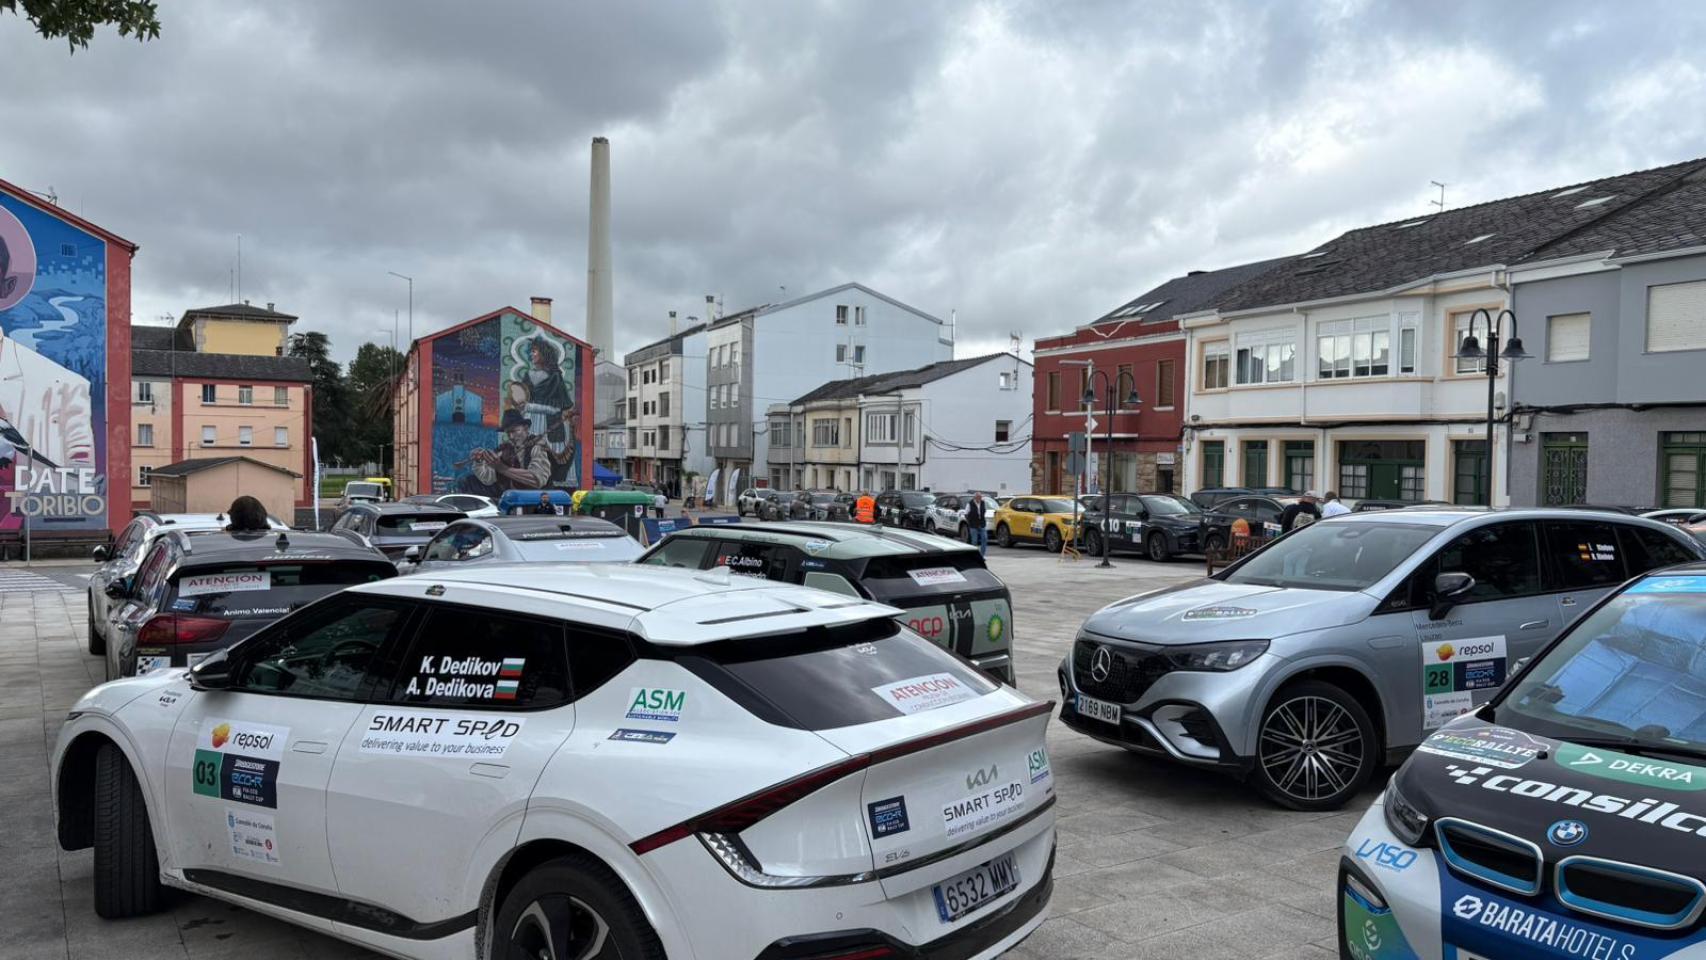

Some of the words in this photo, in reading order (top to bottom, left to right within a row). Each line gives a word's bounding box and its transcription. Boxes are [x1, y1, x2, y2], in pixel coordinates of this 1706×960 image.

[15, 466, 96, 494] DATE
[4, 492, 105, 516] TORIBIO
[1459, 642, 1494, 656] repsol
[420, 656, 435, 673] K.
[440, 657, 501, 676] Dedikov
[406, 677, 421, 695] A.
[425, 678, 494, 698] Dedikova
[889, 677, 958, 701] ATENCIÓN
[1428, 671, 1449, 687] 28
[629, 688, 685, 713] ASM
[1080, 697, 1099, 716] 2169
[1100, 703, 1118, 720] NBM
[369, 716, 449, 734] SMART
[233, 733, 274, 750] repsol
[361, 737, 405, 753] delivering
[405, 740, 429, 751] value
[431, 742, 441, 752] to
[442, 744, 464, 755] your
[465, 745, 505, 755] business
[196, 761, 216, 786] 03
[1028, 748, 1047, 775] ASM
[1609, 760, 1692, 784] DEKRA
[944, 794, 989, 821] SMART
[1481, 775, 1706, 837] consilc
[947, 874, 988, 913] 6532
[988, 857, 1015, 893] MMY
[1480, 901, 1635, 960] BARATAHOTELS
